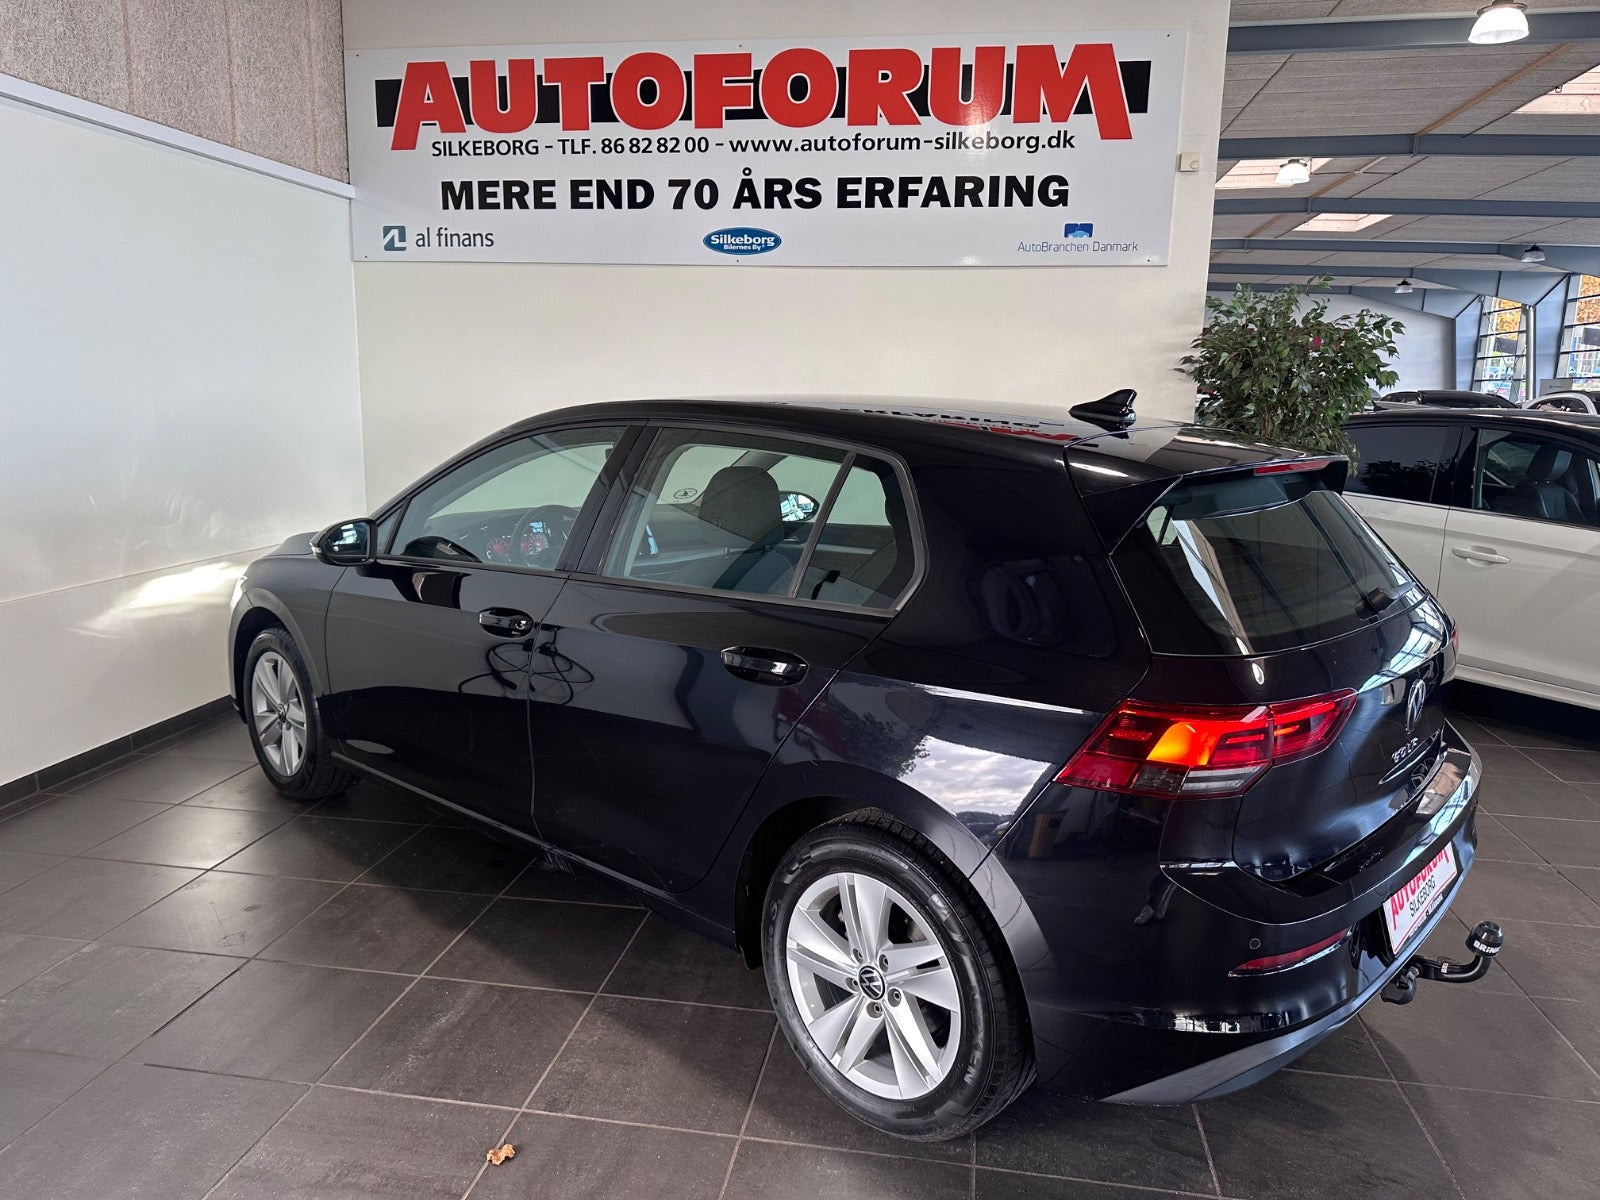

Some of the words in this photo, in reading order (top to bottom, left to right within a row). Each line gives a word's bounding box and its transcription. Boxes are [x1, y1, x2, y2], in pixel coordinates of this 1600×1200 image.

[391, 44, 1132, 150] AUTOFORUM
[431, 139, 539, 157] SILKEBORG
[557, 138, 597, 155] TLF.
[728, 130, 1076, 154] www.autoforum-silkeborg.dk
[440, 180, 557, 210] MERE
[569, 179, 655, 210] END
[667, 178, 720, 210] 70
[732, 167, 823, 210] ÅRS
[836, 174, 1070, 209] ERFARING
[415, 226, 431, 248] al
[436, 226, 495, 248] finans
[710, 234, 776, 247] Silkeborg
[1017, 240, 1089, 253] AutoBranchen
[1091, 240, 1139, 252] Danmark
[1408, 875, 1437, 918] SILKEBORG
